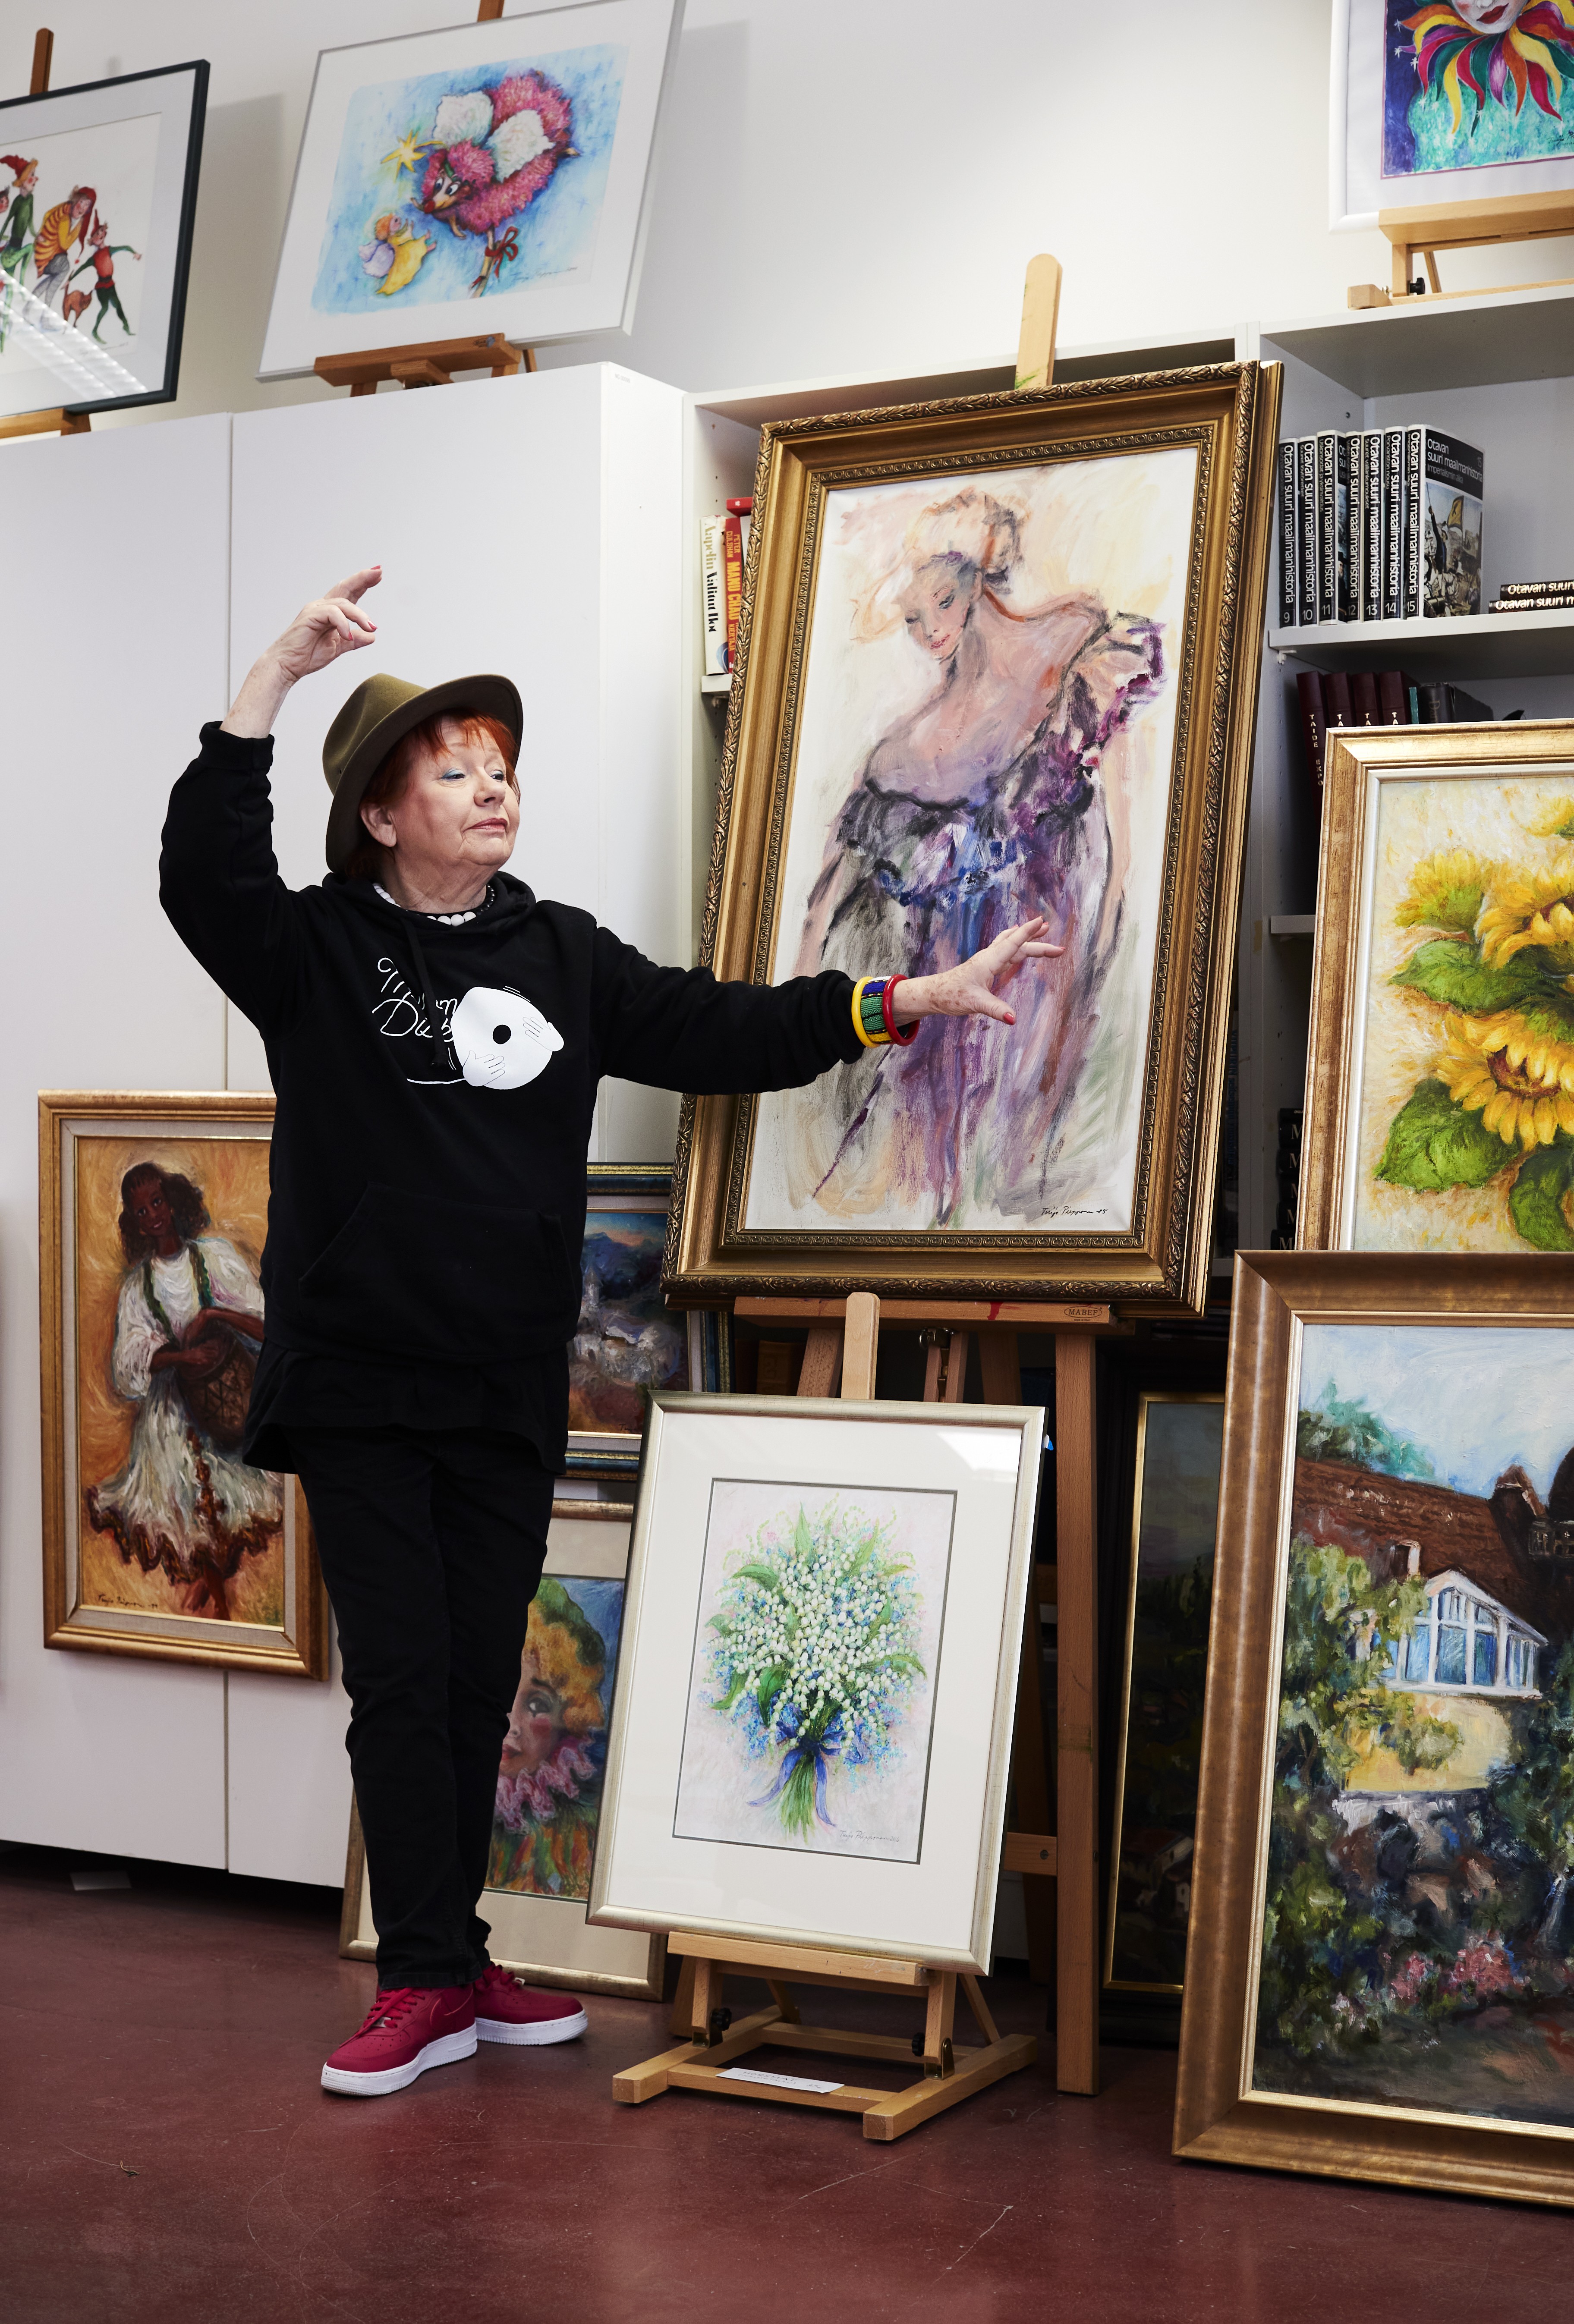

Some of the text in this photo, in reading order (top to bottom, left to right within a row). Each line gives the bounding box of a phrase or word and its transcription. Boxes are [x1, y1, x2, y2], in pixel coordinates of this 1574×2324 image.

[1427, 438, 1449, 454] Otavan
[1427, 452, 1483, 482] suuri maailmanhistoria
[1284, 445, 1295, 603] Otavan suuri maailmanhistoria
[1304, 443, 1316, 603] Otavan suuri maailmanhistoria
[1324, 437, 1335, 598] Otavan suuri maailmanhistoria
[1350, 438, 1360, 598] Otavan suuri maailmanhistoria
[1370, 437, 1380, 598] Otavan suuri maailmanhistoria
[1389, 434, 1401, 596] Otavan suuri maailmanhistoria
[1409, 432, 1420, 594] Otavan suuri maailmanhistoria
[727, 561, 740, 591] MANU
[1508, 583, 1546, 595] Otavan
[1302, 609, 1313, 620] 10
[1322, 604, 1330, 615] 11
[1348, 605, 1356, 615] 12
[1366, 604, 1378, 616] 13
[1385, 602, 1397, 613] 14
[1407, 601, 1416, 612] 15
[1495, 599, 1534, 610] Otavan
[1536, 596, 1564, 607] suuri
[1284, 612, 1290, 623] 9
[1309, 714, 1319, 748] TAIDE
